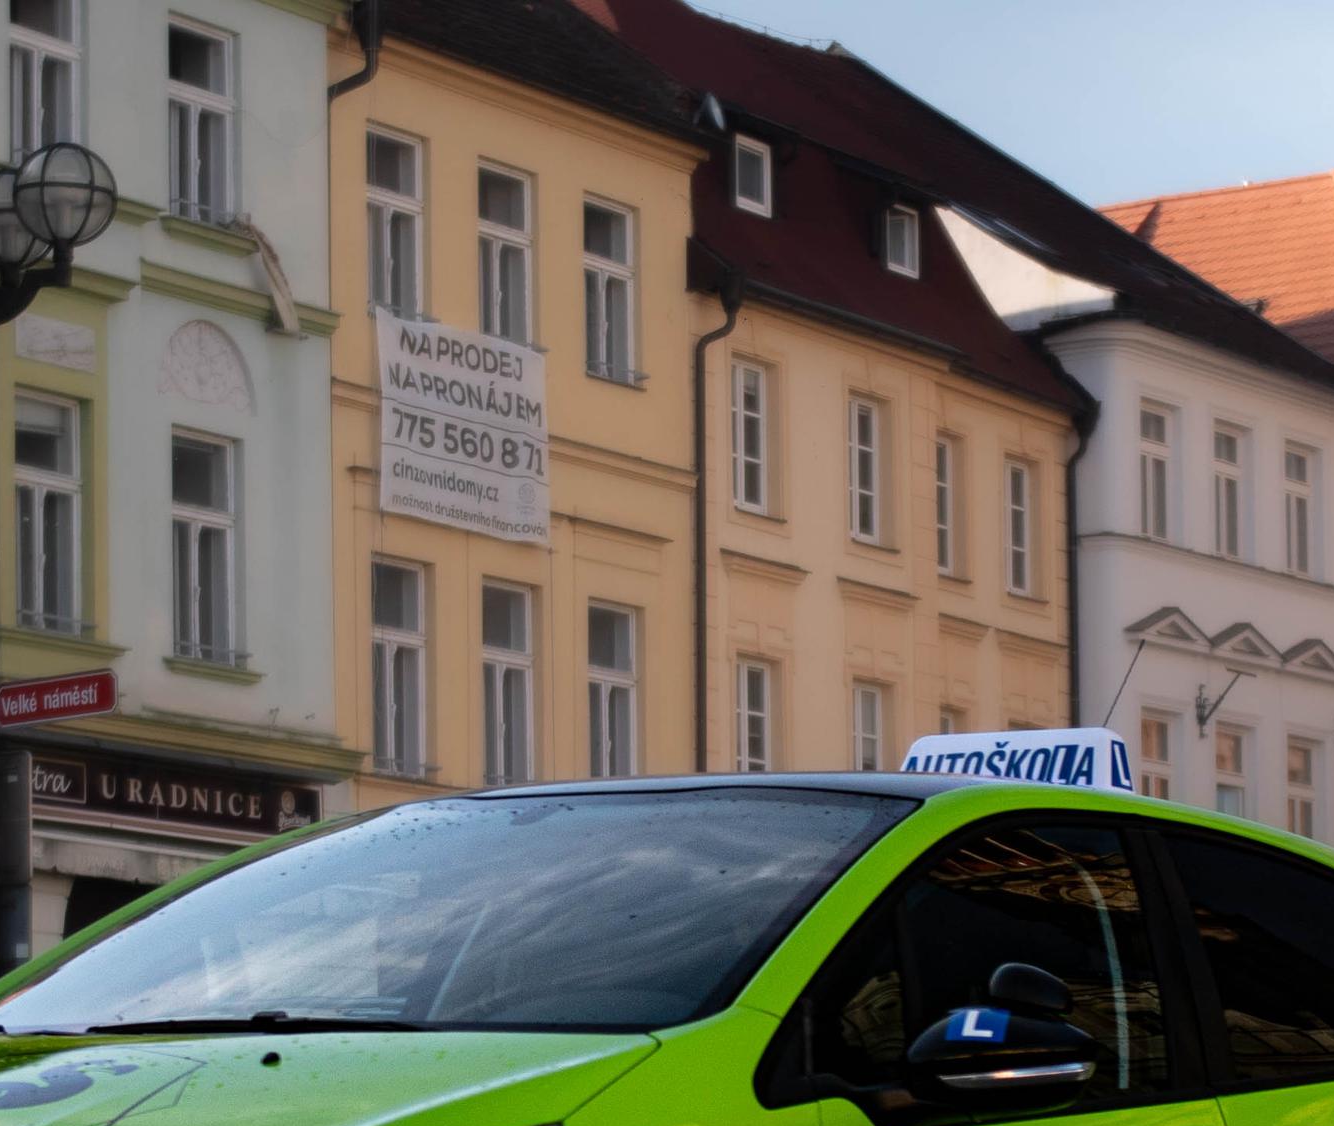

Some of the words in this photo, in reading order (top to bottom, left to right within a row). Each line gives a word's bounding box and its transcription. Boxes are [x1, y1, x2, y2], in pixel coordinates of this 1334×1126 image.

[392, 407, 435, 448] 775
[443, 423, 494, 463] 560
[2, 691, 38, 717] Velké
[43, 682, 99, 710] náměstí
[100, 774, 116, 799] U
[126, 778, 262, 820] RADNICE
[961, 1010, 994, 1038] L
